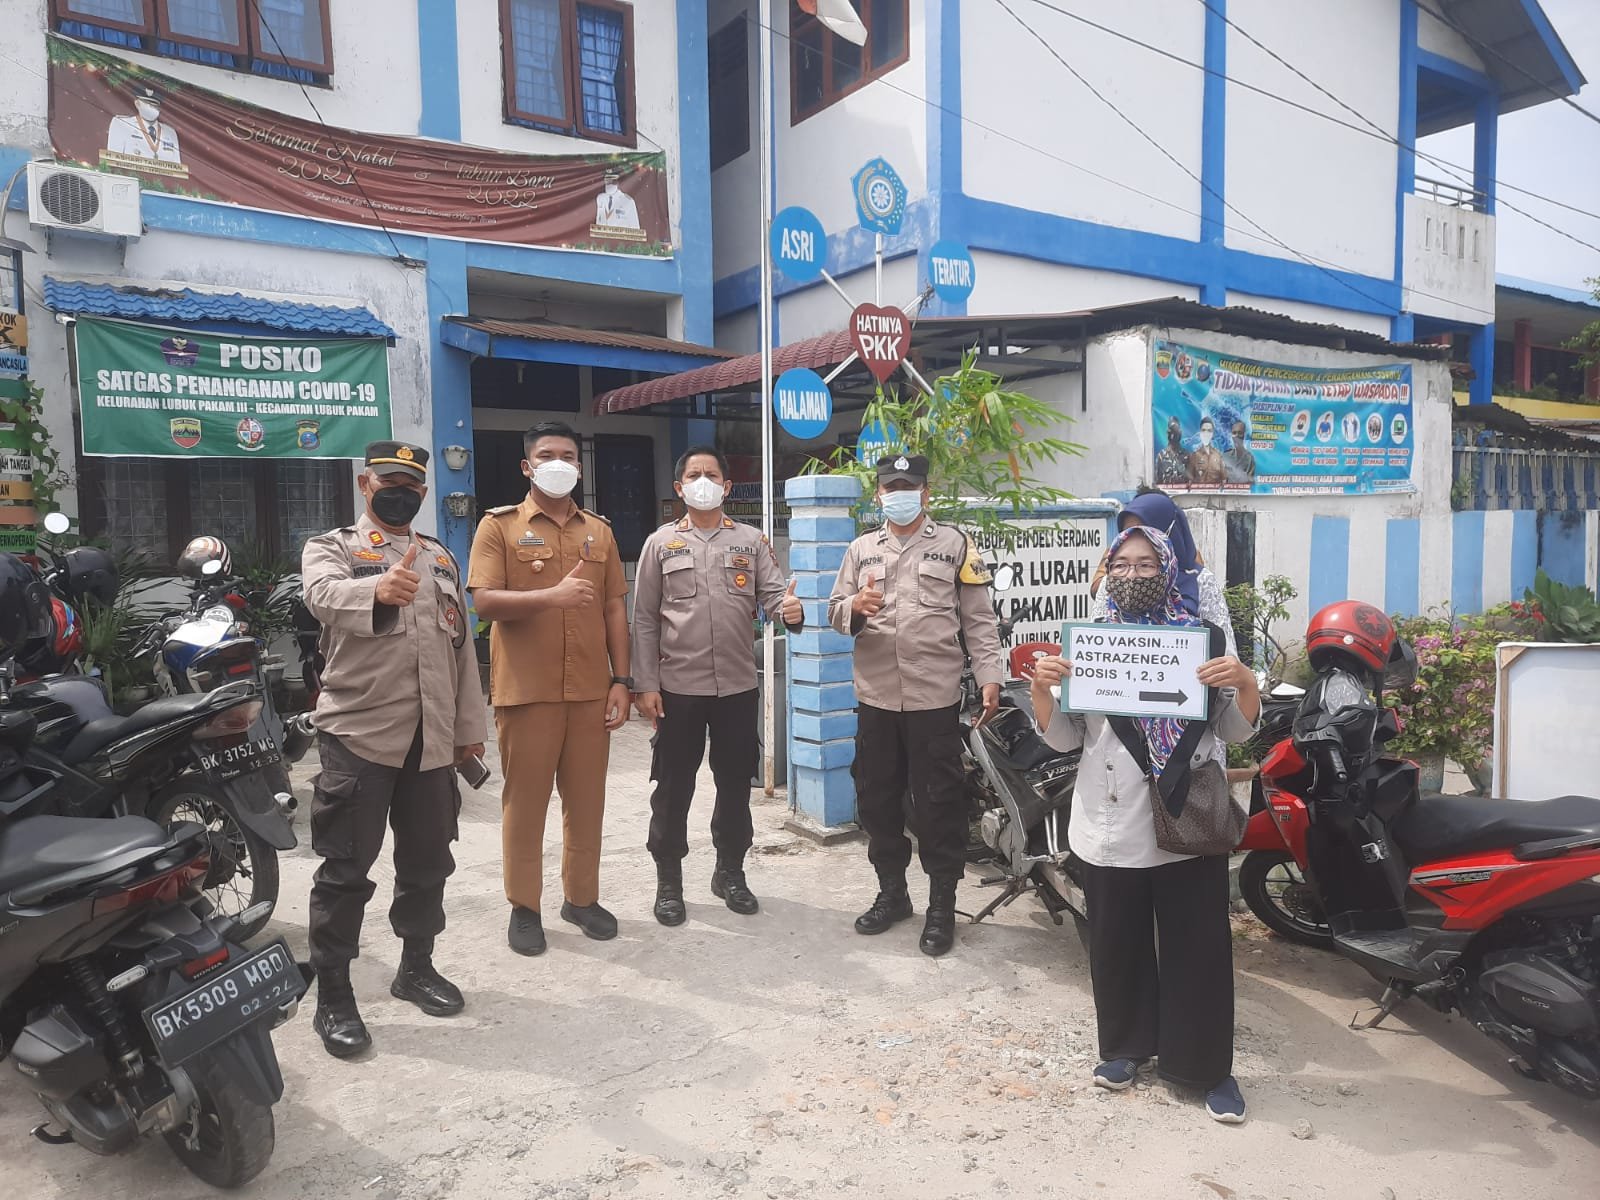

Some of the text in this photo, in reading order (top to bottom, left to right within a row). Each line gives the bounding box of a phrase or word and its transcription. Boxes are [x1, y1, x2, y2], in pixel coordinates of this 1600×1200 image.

[226, 119, 319, 153] Selamat
[327, 143, 397, 167] Natal
[466, 184, 537, 208] 2022
[780, 227, 814, 262] ASRI
[932, 257, 971, 287] TERATUR
[856, 314, 902, 334] HATINYA
[219, 343, 322, 373] POSKO
[858, 334, 902, 361] PKK
[97, 369, 376, 402] SATGAS PENANGANAN COVID-19
[1214, 370, 1251, 391] TIDAK
[1353, 383, 1398, 400] WASPADA
[96, 395, 159, 409] KELURAHAN
[162, 398, 196, 411] LUBUK
[199, 400, 234, 412] PAKAM
[236, 402, 247, 413] III
[256, 402, 313, 415] KECAMATAN
[315, 404, 345, 416] LUBUK
[347, 406, 379, 417] PAKAM
[779, 389, 827, 422] HALAMAN
[10, 457, 32, 470] TANGGA
[729, 545, 753, 554] POLRI
[1033, 530, 1055, 548] DELI
[1057, 529, 1101, 548] SERDANG
[923, 552, 956, 565] POLRI
[1030, 559, 1089, 587] LURAH
[1073, 594, 1088, 619] III
[1075, 634, 1104, 646] AYO
[1075, 650, 1180, 666] ASTRAZENECA
[1075, 667, 1165, 683] DOSIS 1, 2, 3
[201, 737, 275, 770] BK 3752 MG
